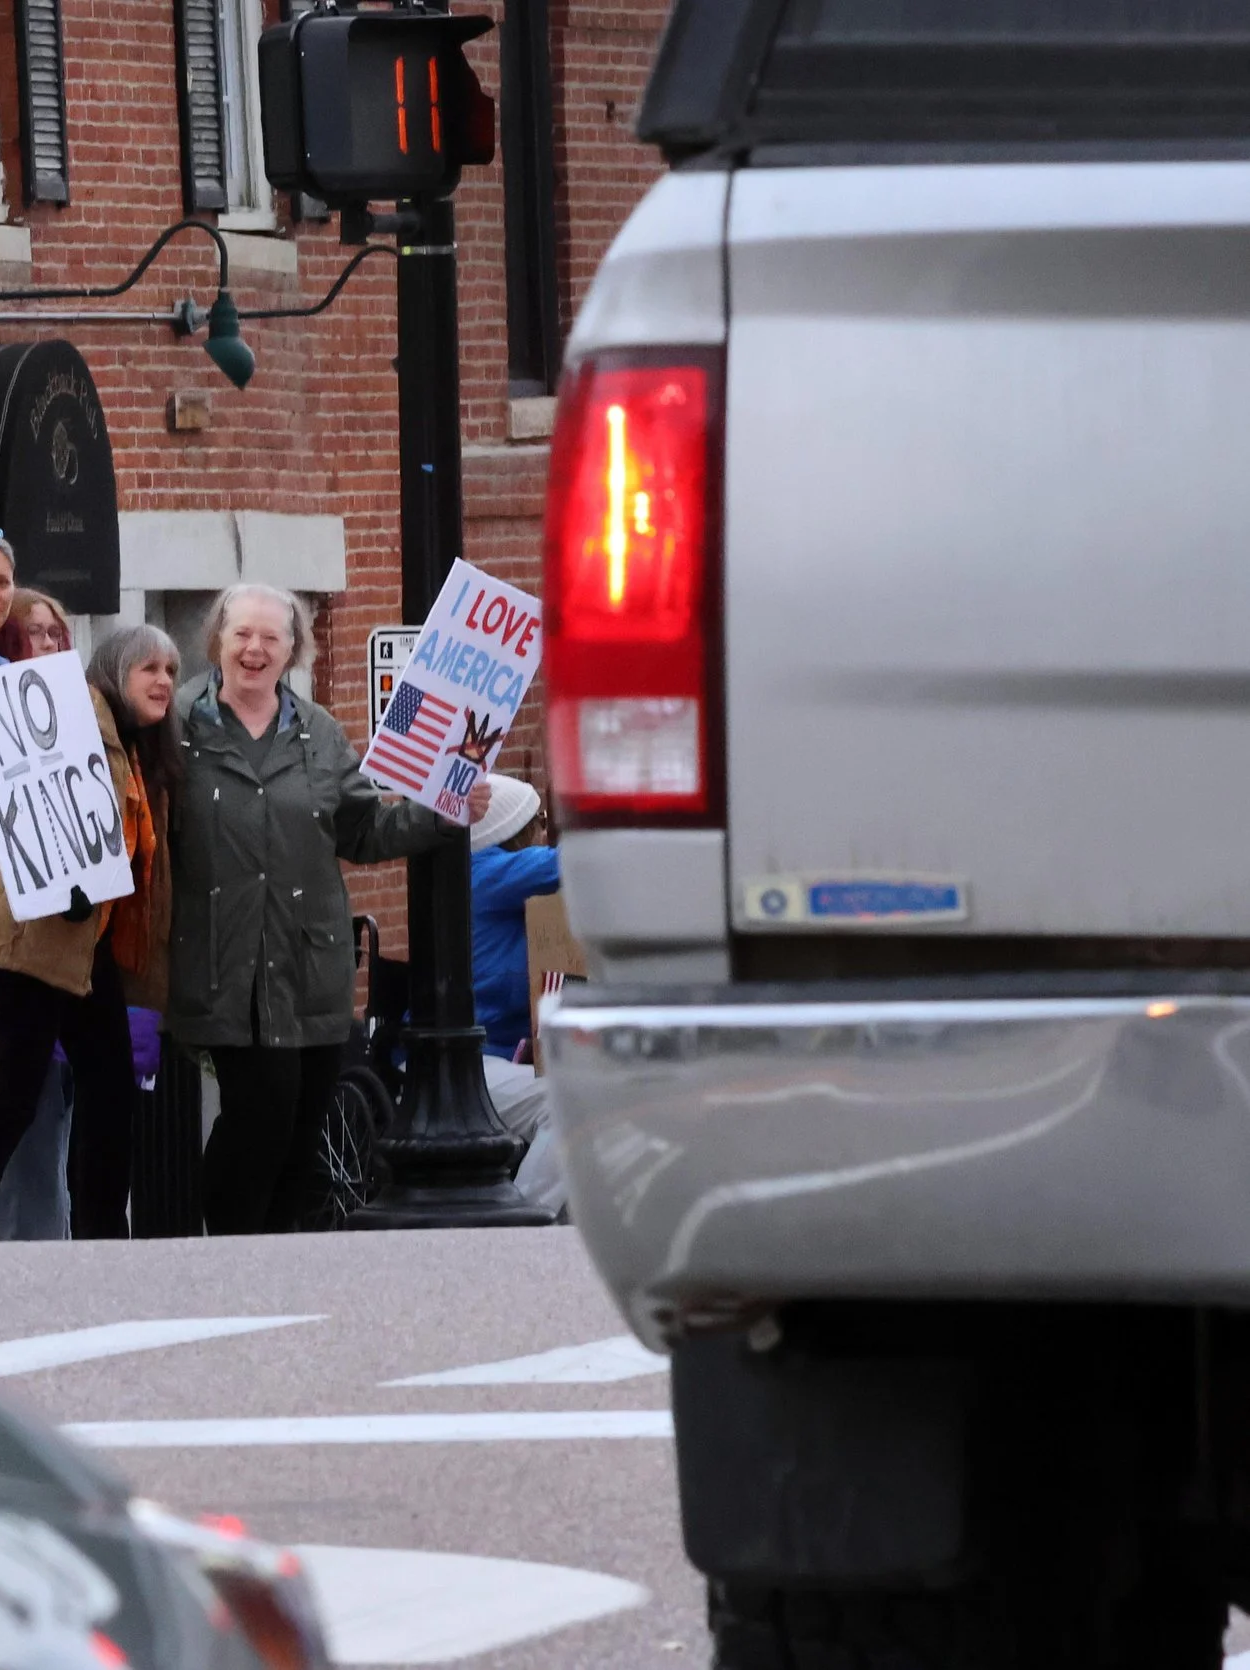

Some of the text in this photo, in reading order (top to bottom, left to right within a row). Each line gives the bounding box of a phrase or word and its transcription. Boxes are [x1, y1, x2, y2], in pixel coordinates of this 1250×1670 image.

[395, 56, 441, 154] 11
[450, 580, 541, 658] I LOVE
[413, 629, 525, 715] AMERICA
[434, 789, 465, 818] KINGS
[442, 758, 478, 797] NO
